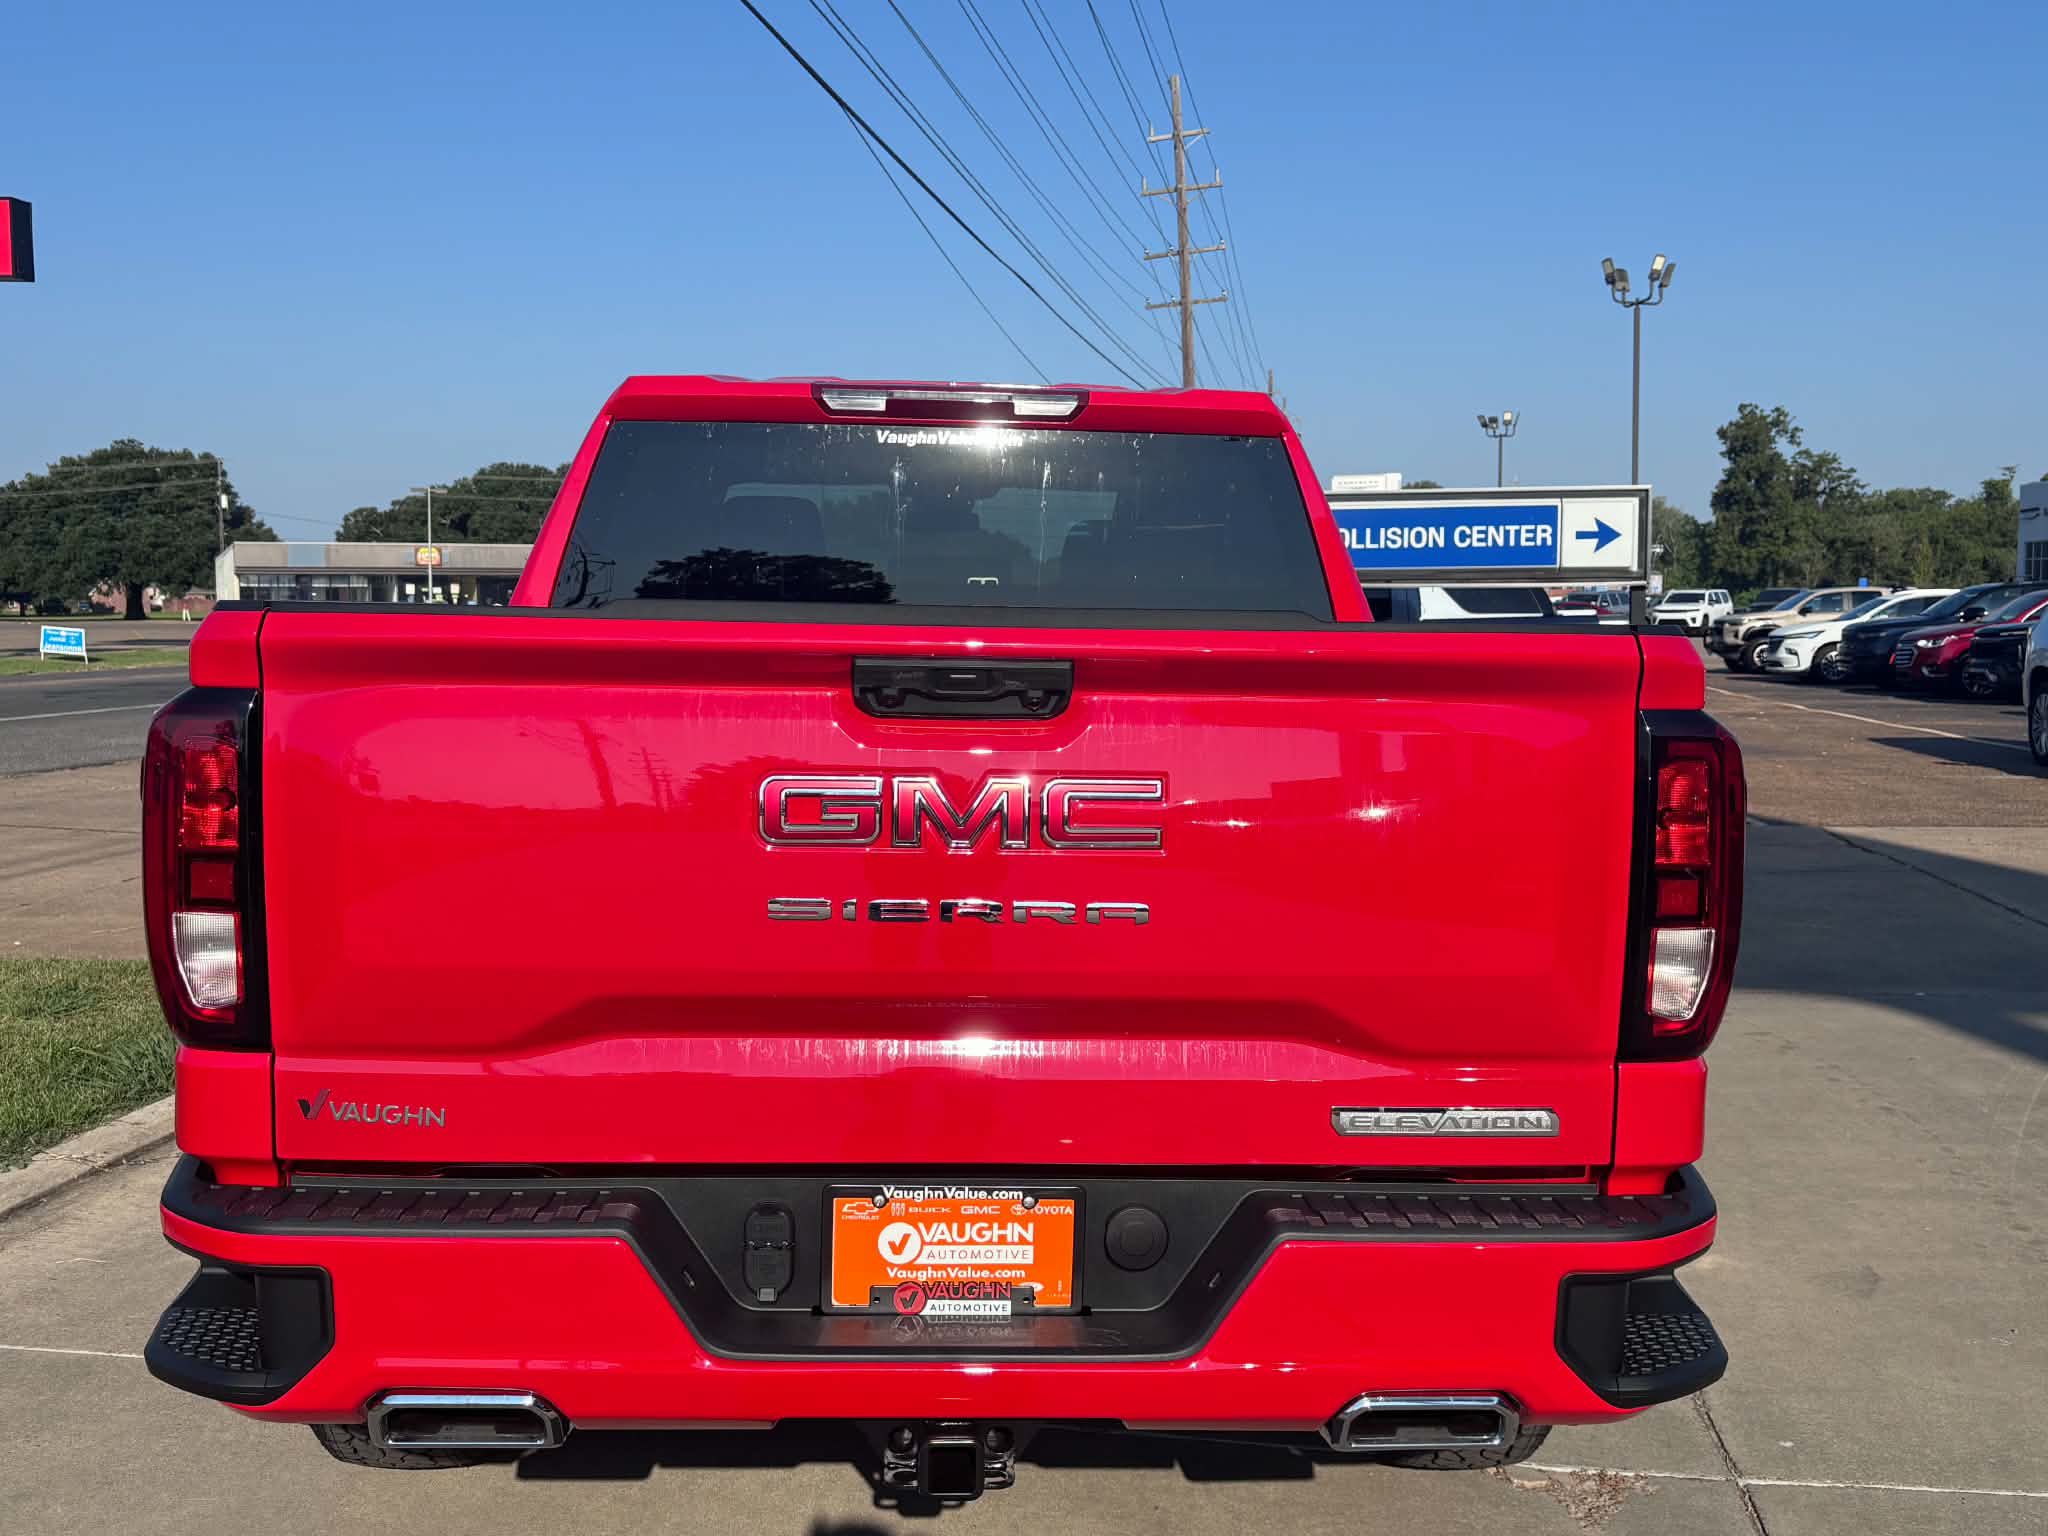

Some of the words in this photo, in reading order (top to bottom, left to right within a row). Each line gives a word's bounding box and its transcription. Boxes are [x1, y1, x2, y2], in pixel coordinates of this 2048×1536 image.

[1338, 526, 1445, 549] OLLISION
[1453, 524, 1553, 548] CENTER
[758, 774, 1165, 850] GMC
[767, 897, 1150, 926] SIERRA
[329, 1101, 446, 1127] VAUGHN
[1349, 1113, 1544, 1130] ELEVATION
[882, 1186, 1024, 1202] VaughnValue.com
[960, 1205, 1001, 1215] GMC
[918, 1222, 1034, 1243] VAUGHN
[927, 1248, 1030, 1260] AUTOMOTIVE
[886, 1267, 1026, 1281] VaughnValue.com
[922, 1281, 1012, 1299] VAUGHN
[930, 1303, 1008, 1312] AUTOMOTIVE
